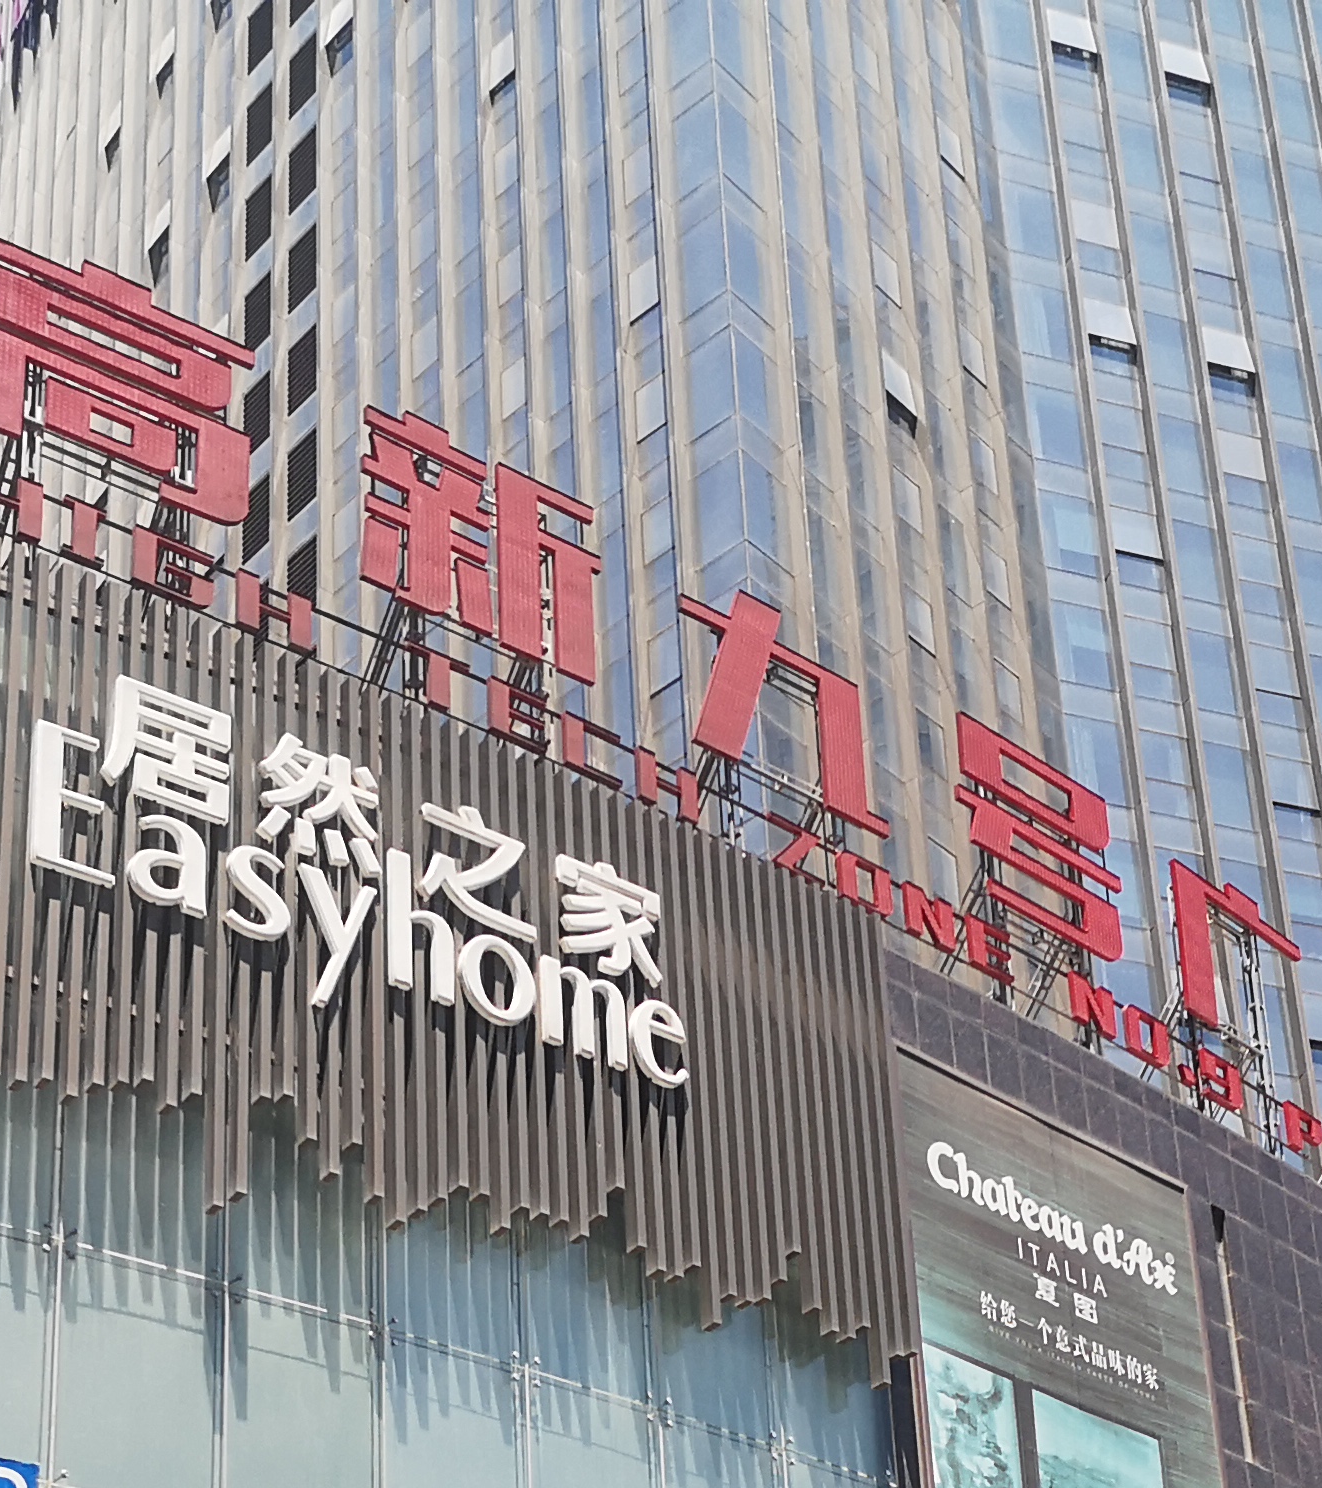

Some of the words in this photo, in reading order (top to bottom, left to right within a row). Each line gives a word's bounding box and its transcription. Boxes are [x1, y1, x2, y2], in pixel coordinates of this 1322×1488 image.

[31, 718, 691, 1090] Easyhome
[102, 674, 662, 989] 居然之家
[765, 810, 1015, 986] ZONE
[1067, 971, 1243, 1111] NO.9
[927, 1141, 1088, 1254] Chateau
[1016, 1237, 1108, 1298] ITALIA
